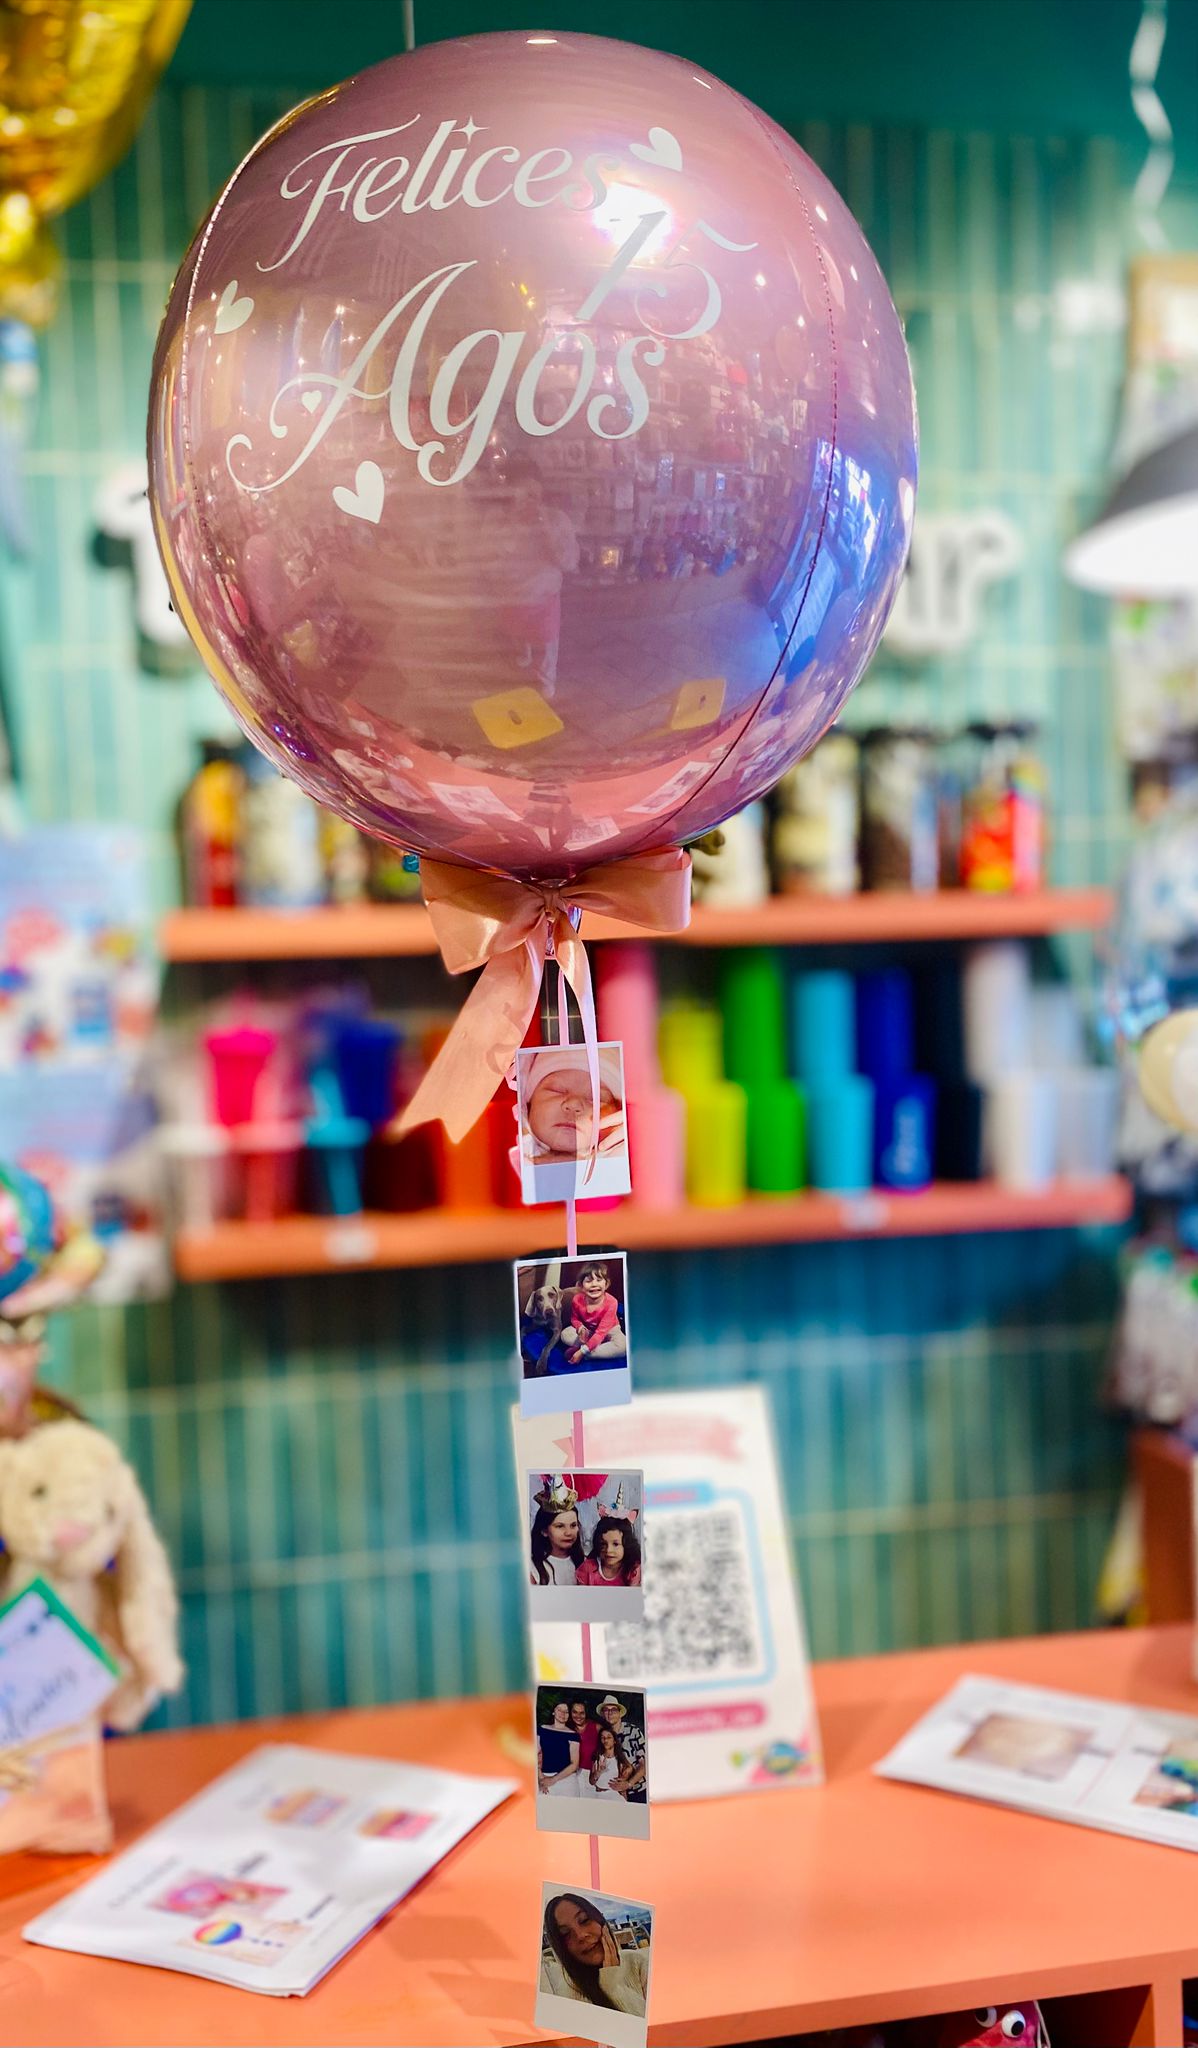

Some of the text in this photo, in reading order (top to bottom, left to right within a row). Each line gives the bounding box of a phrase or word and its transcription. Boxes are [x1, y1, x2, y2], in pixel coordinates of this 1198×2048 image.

[256, 114, 621, 272] Felices
[575, 209, 759, 340] 15
[225, 260, 665, 492] Agos
